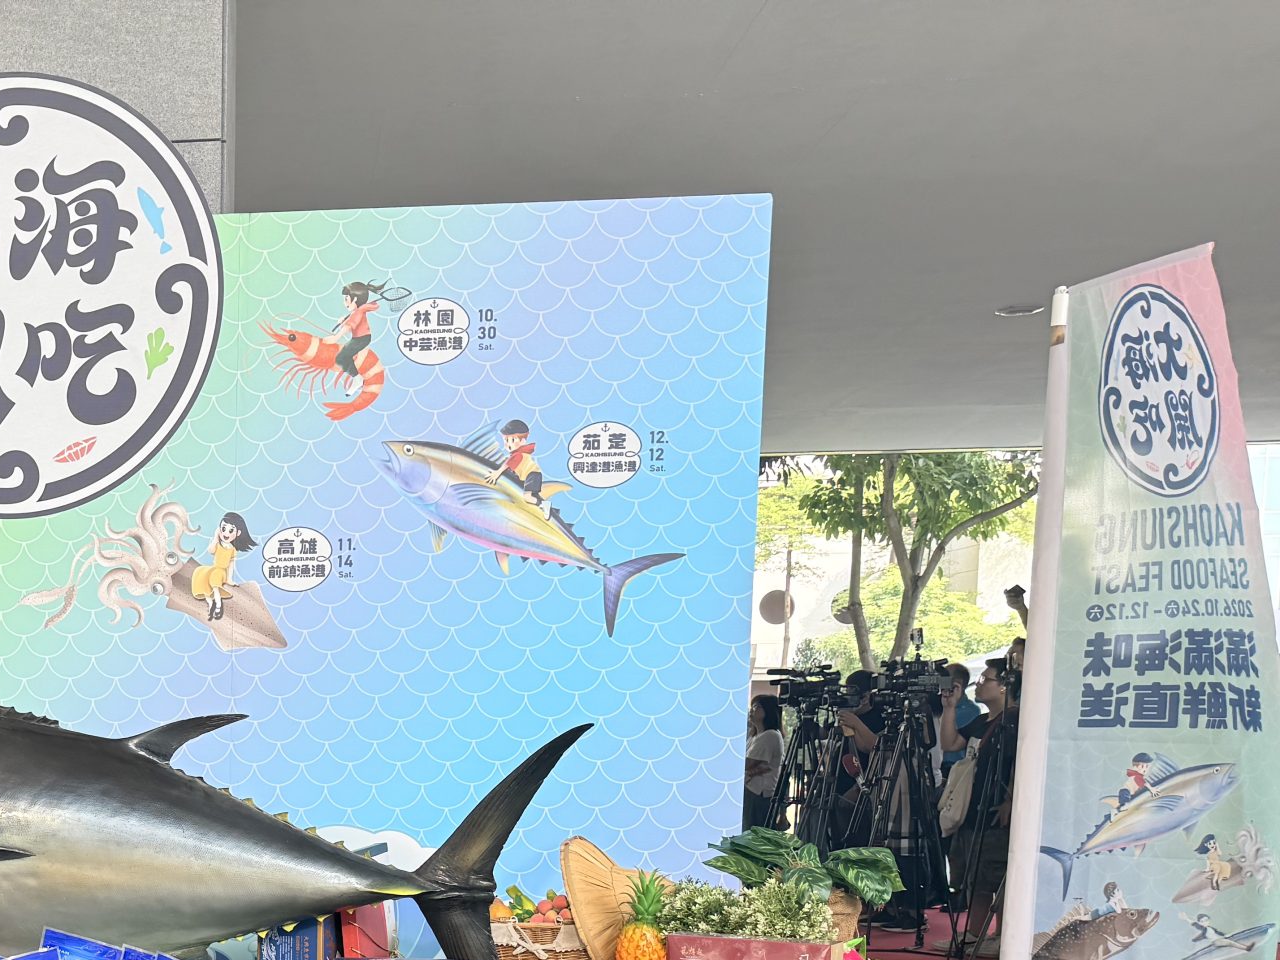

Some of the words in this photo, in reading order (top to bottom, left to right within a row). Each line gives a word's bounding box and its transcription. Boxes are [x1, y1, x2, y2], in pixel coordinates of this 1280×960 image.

[413, 309, 454, 327] 林園
[478, 308, 497, 322] 10.
[477, 326, 497, 340] 30
[403, 336, 463, 351] 中芸漁港
[478, 343, 495, 351] Sat.
[649, 430, 669, 444] 12.
[649, 448, 664, 461] 12
[649, 464, 666, 472] Sat.
[277, 538, 318, 555] 高雄
[338, 538, 356, 551] 11.
[337, 554, 353, 568] 14
[268, 564, 326, 578] 前鎮漁港
